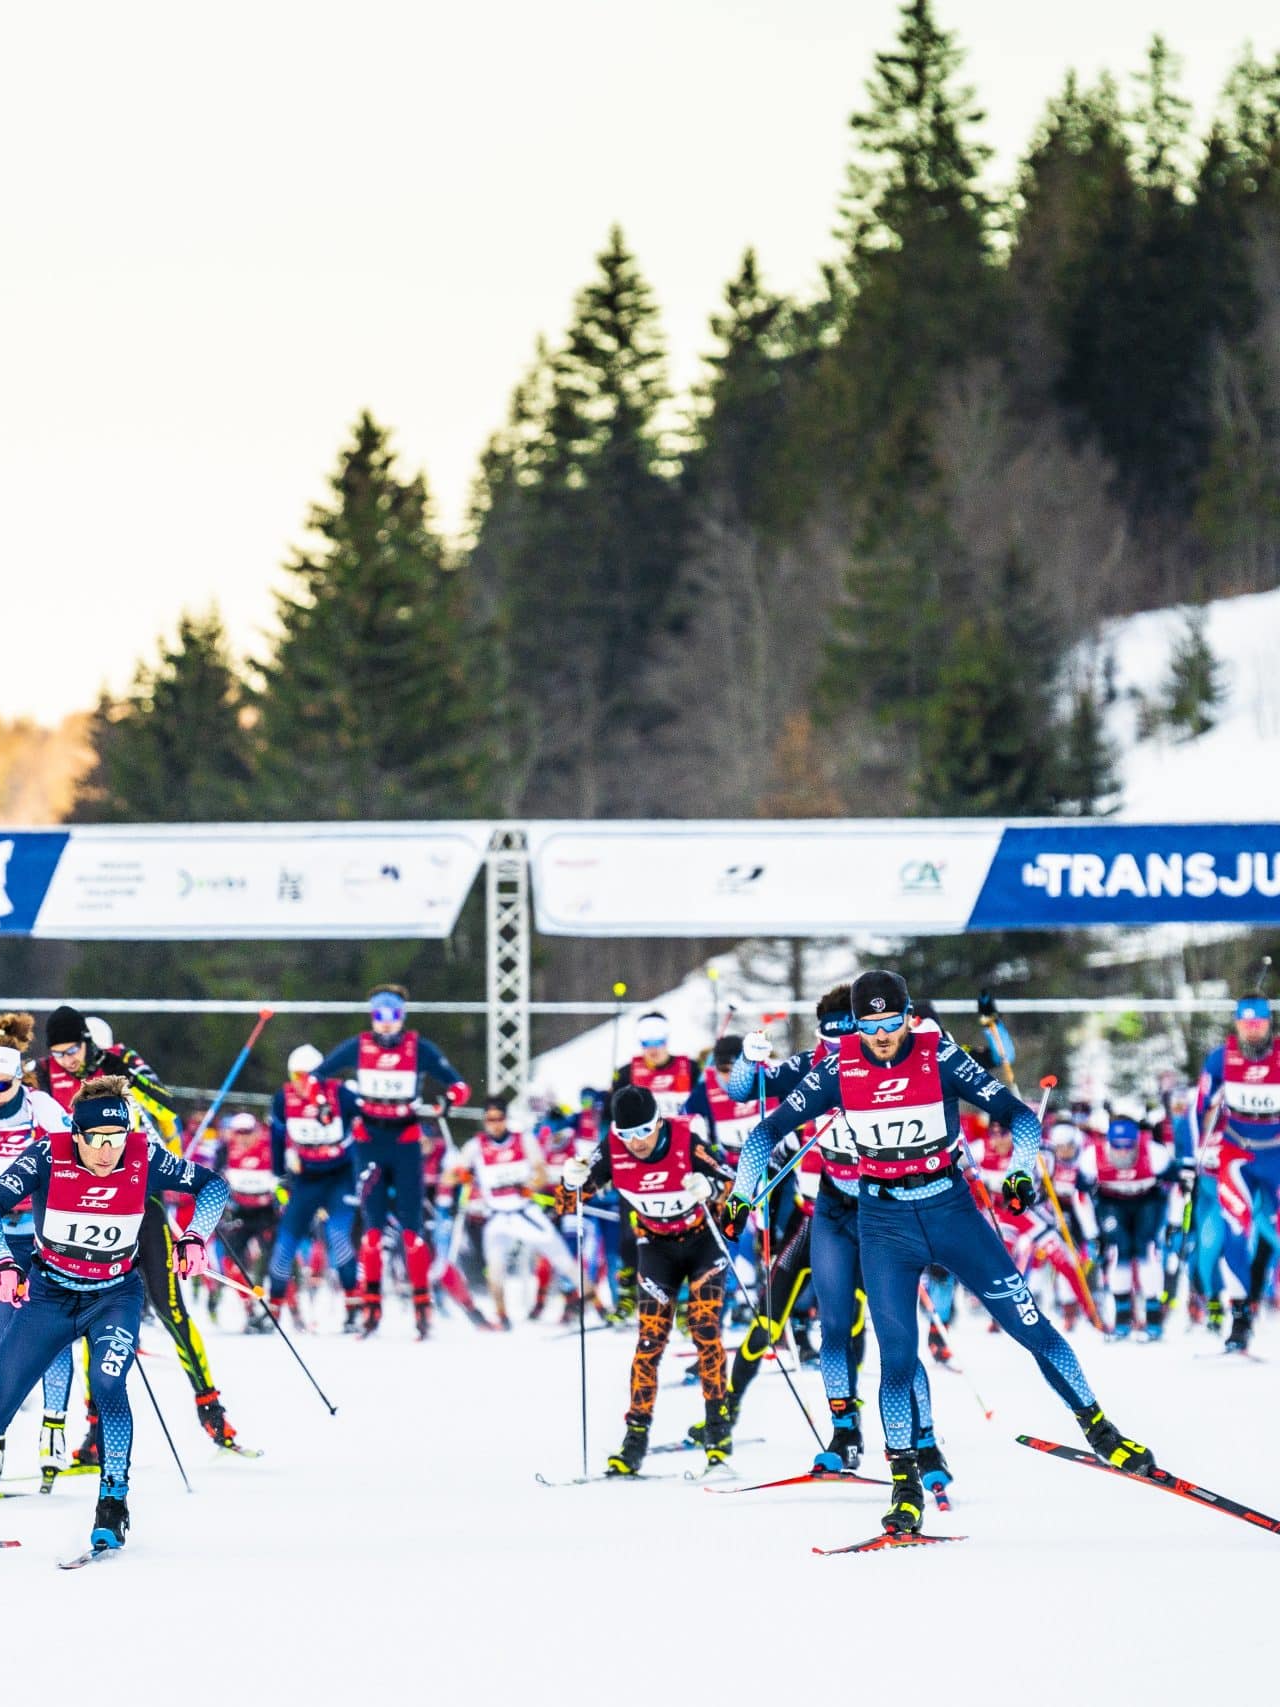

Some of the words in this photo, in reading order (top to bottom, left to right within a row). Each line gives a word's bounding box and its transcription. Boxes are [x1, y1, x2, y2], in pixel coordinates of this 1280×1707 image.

[831, 1126, 856, 1150] 13
[869, 1119, 926, 1147] 172
[76, 1199, 113, 1209] Julbo
[64, 1223, 122, 1248] 129
